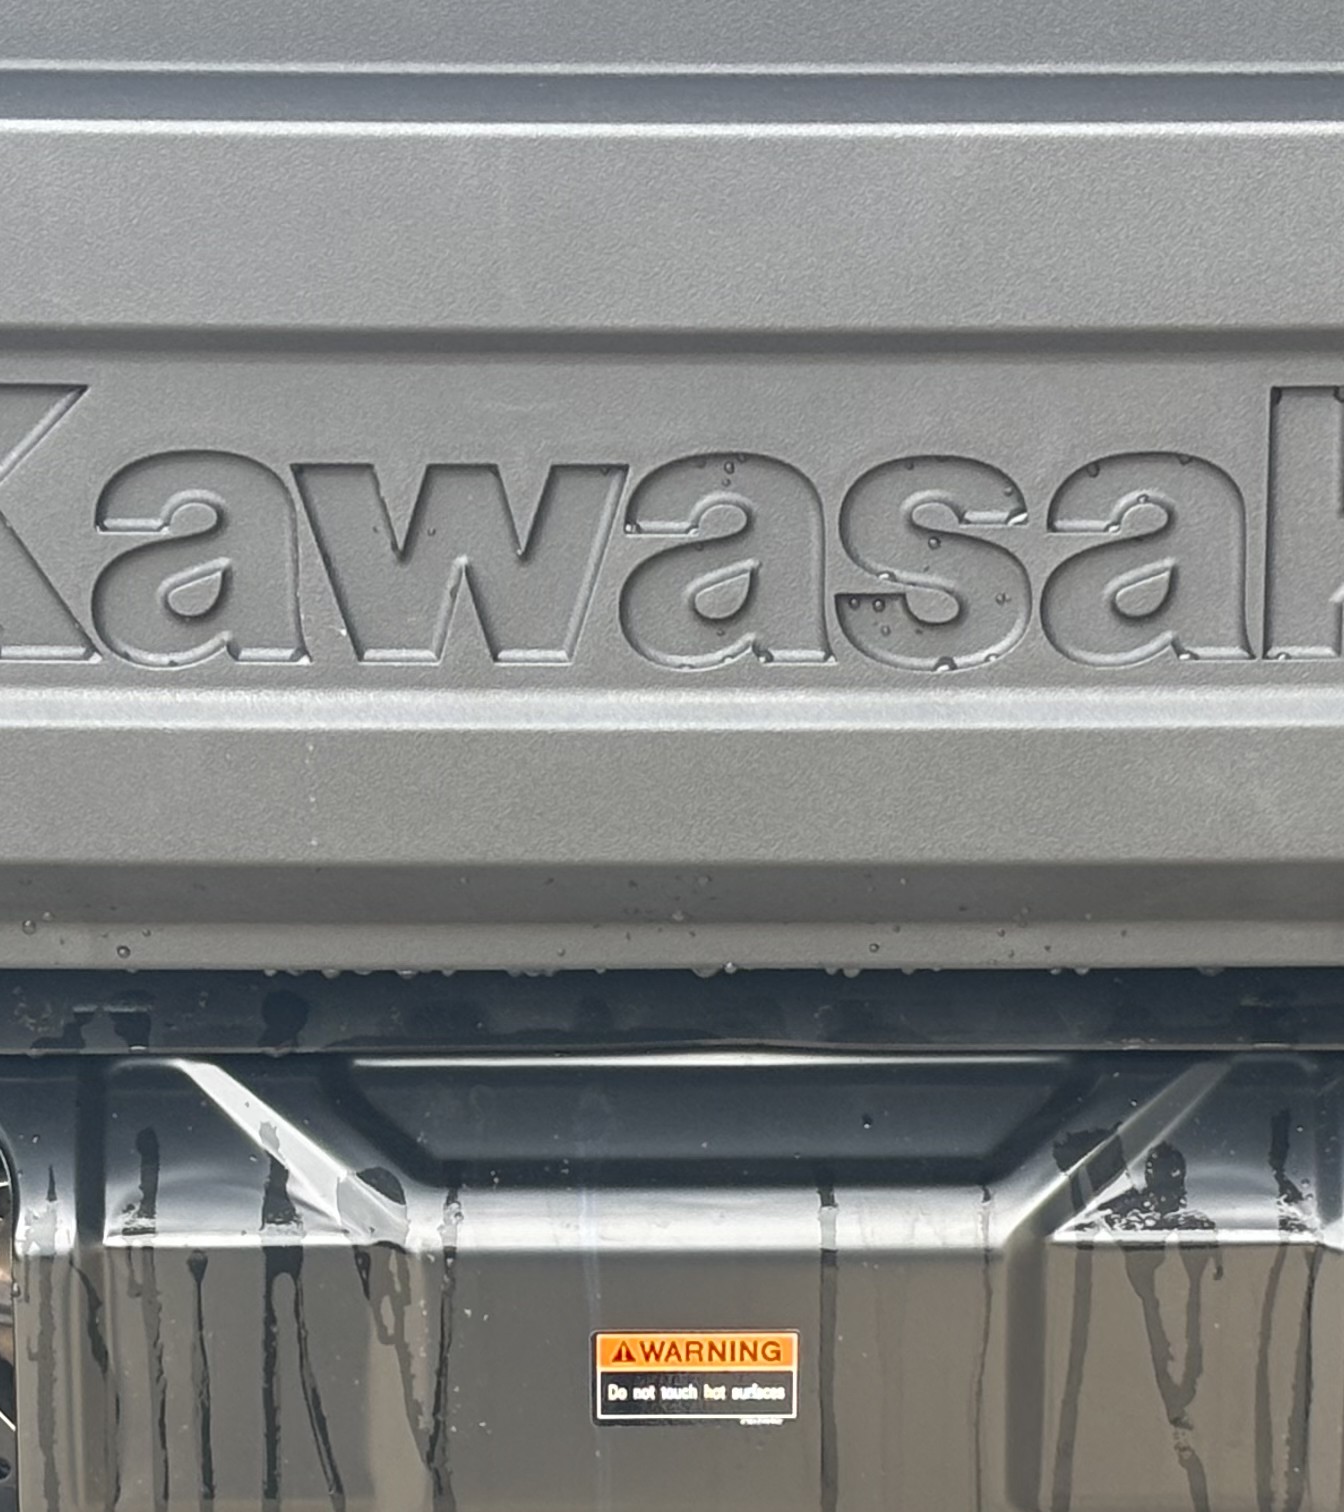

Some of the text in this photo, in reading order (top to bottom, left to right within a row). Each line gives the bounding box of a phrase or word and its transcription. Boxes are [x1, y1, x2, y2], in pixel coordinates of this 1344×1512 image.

[639, 1340, 782, 1362] WARNING
[607, 1383, 786, 1401] Do not touch hot surfaces
